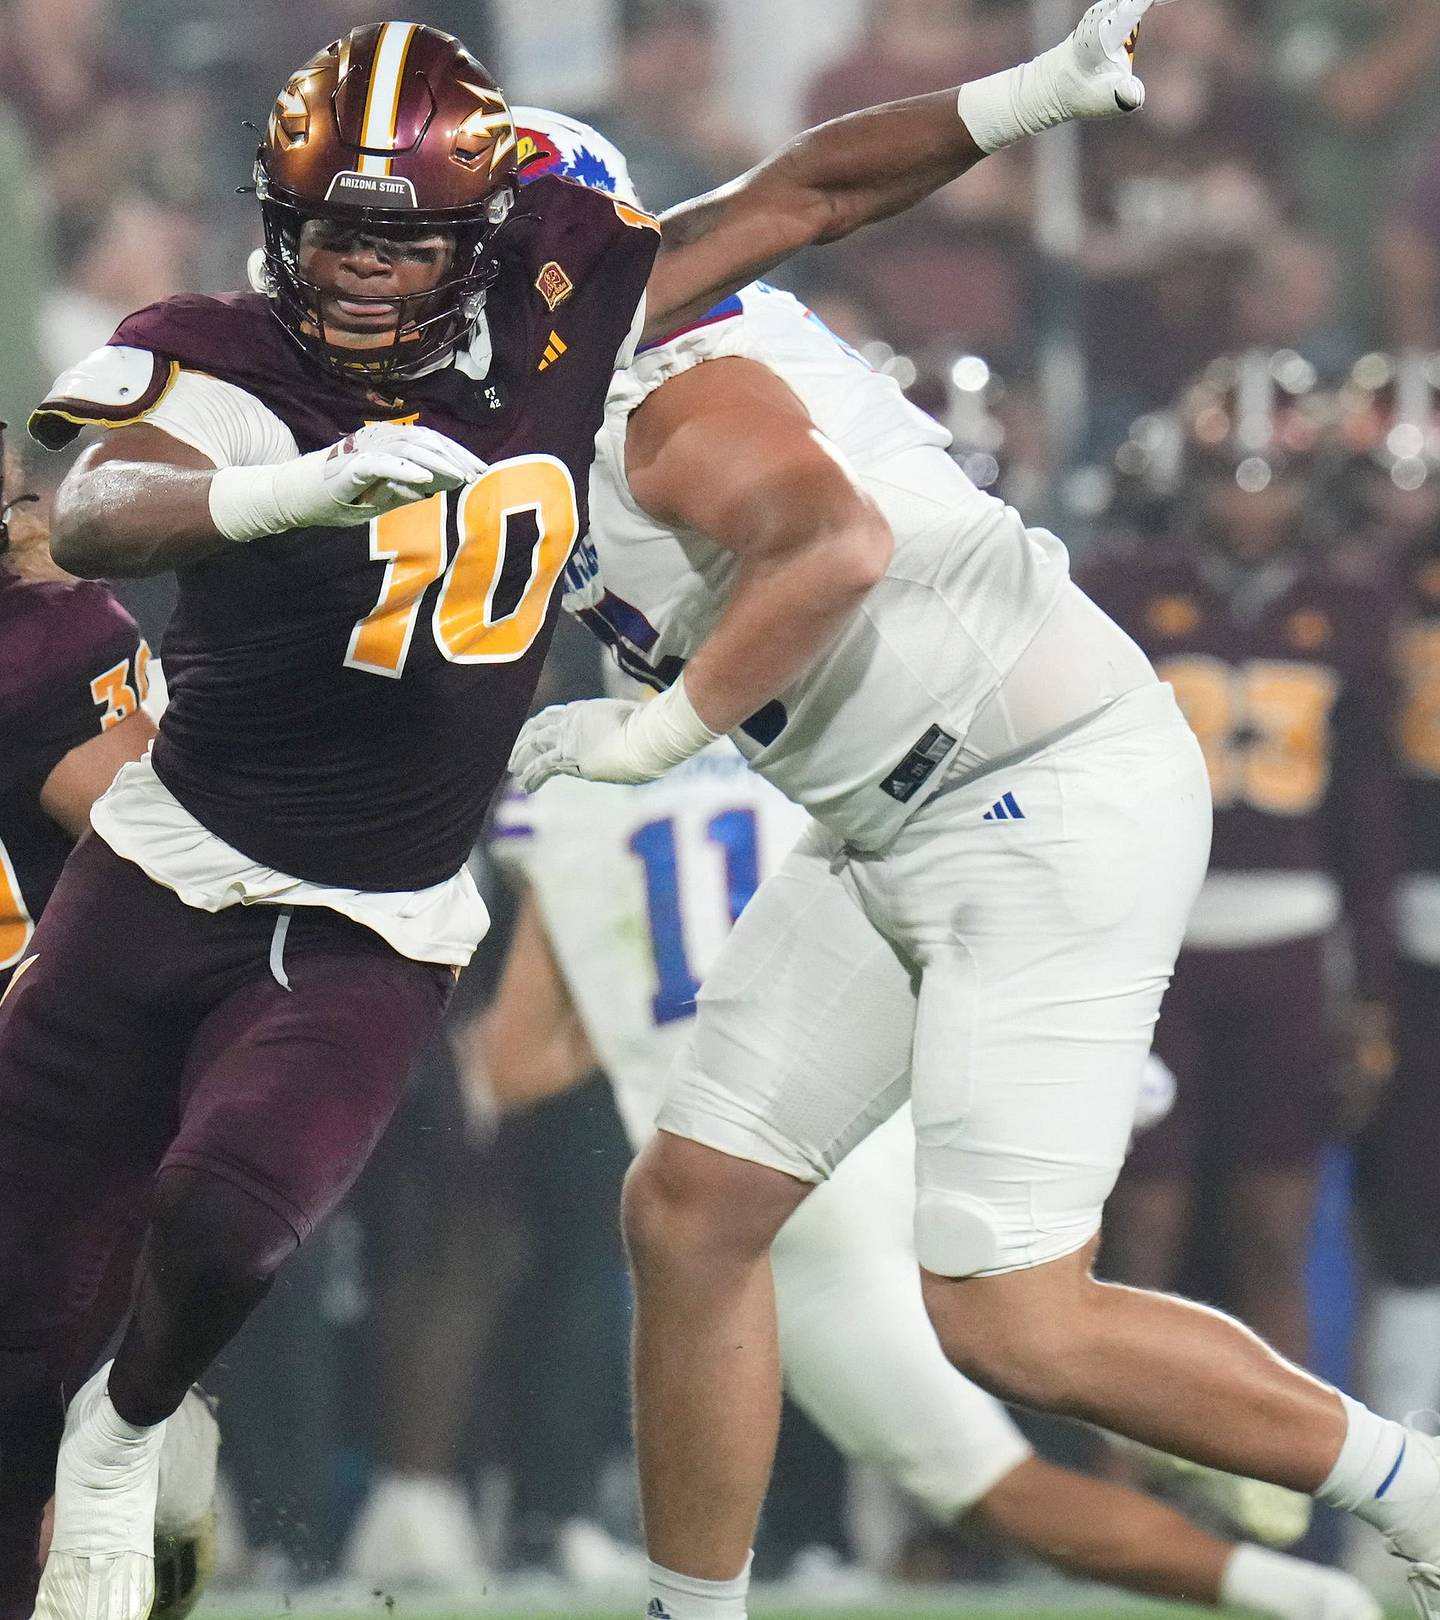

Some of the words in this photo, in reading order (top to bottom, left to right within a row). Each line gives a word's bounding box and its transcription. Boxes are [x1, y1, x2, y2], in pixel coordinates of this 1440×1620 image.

[340, 177, 377, 191] ARIZONA
[379, 182, 406, 194] STATE
[484, 386, 496, 399] PT
[490, 398, 501, 409] 42
[343, 453, 580, 680] 10
[628, 807, 761, 1028] 11
